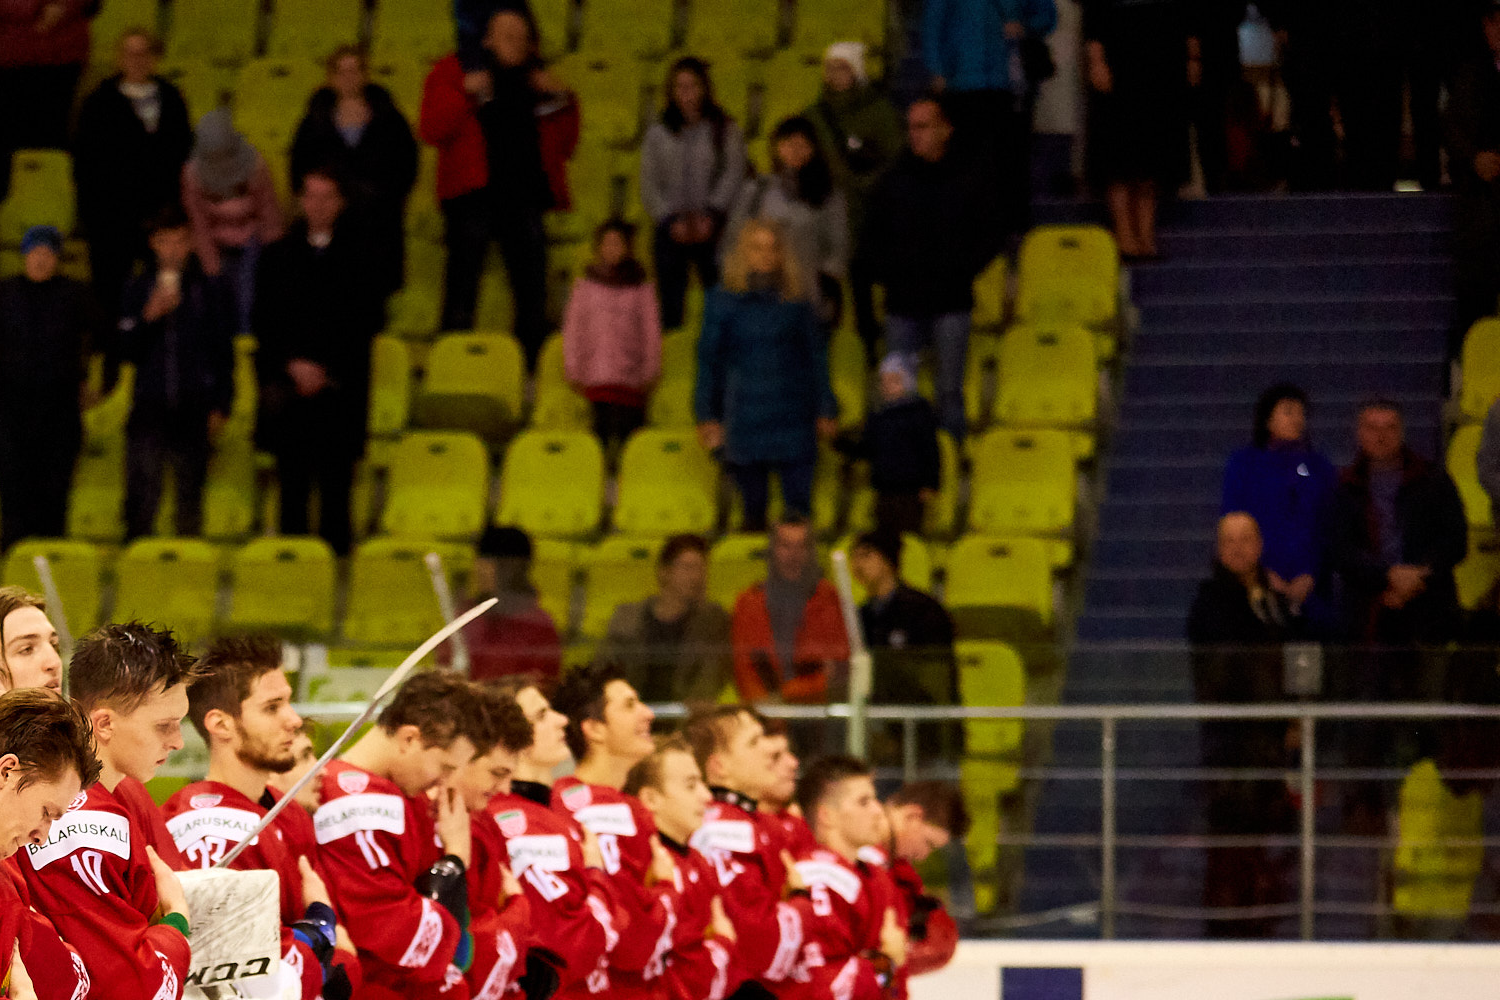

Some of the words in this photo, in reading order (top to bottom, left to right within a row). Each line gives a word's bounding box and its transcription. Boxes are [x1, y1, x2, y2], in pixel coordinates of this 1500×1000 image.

[355, 829, 390, 870] 11
[70, 850, 110, 896] 10
[184, 956, 271, 986] CCM
